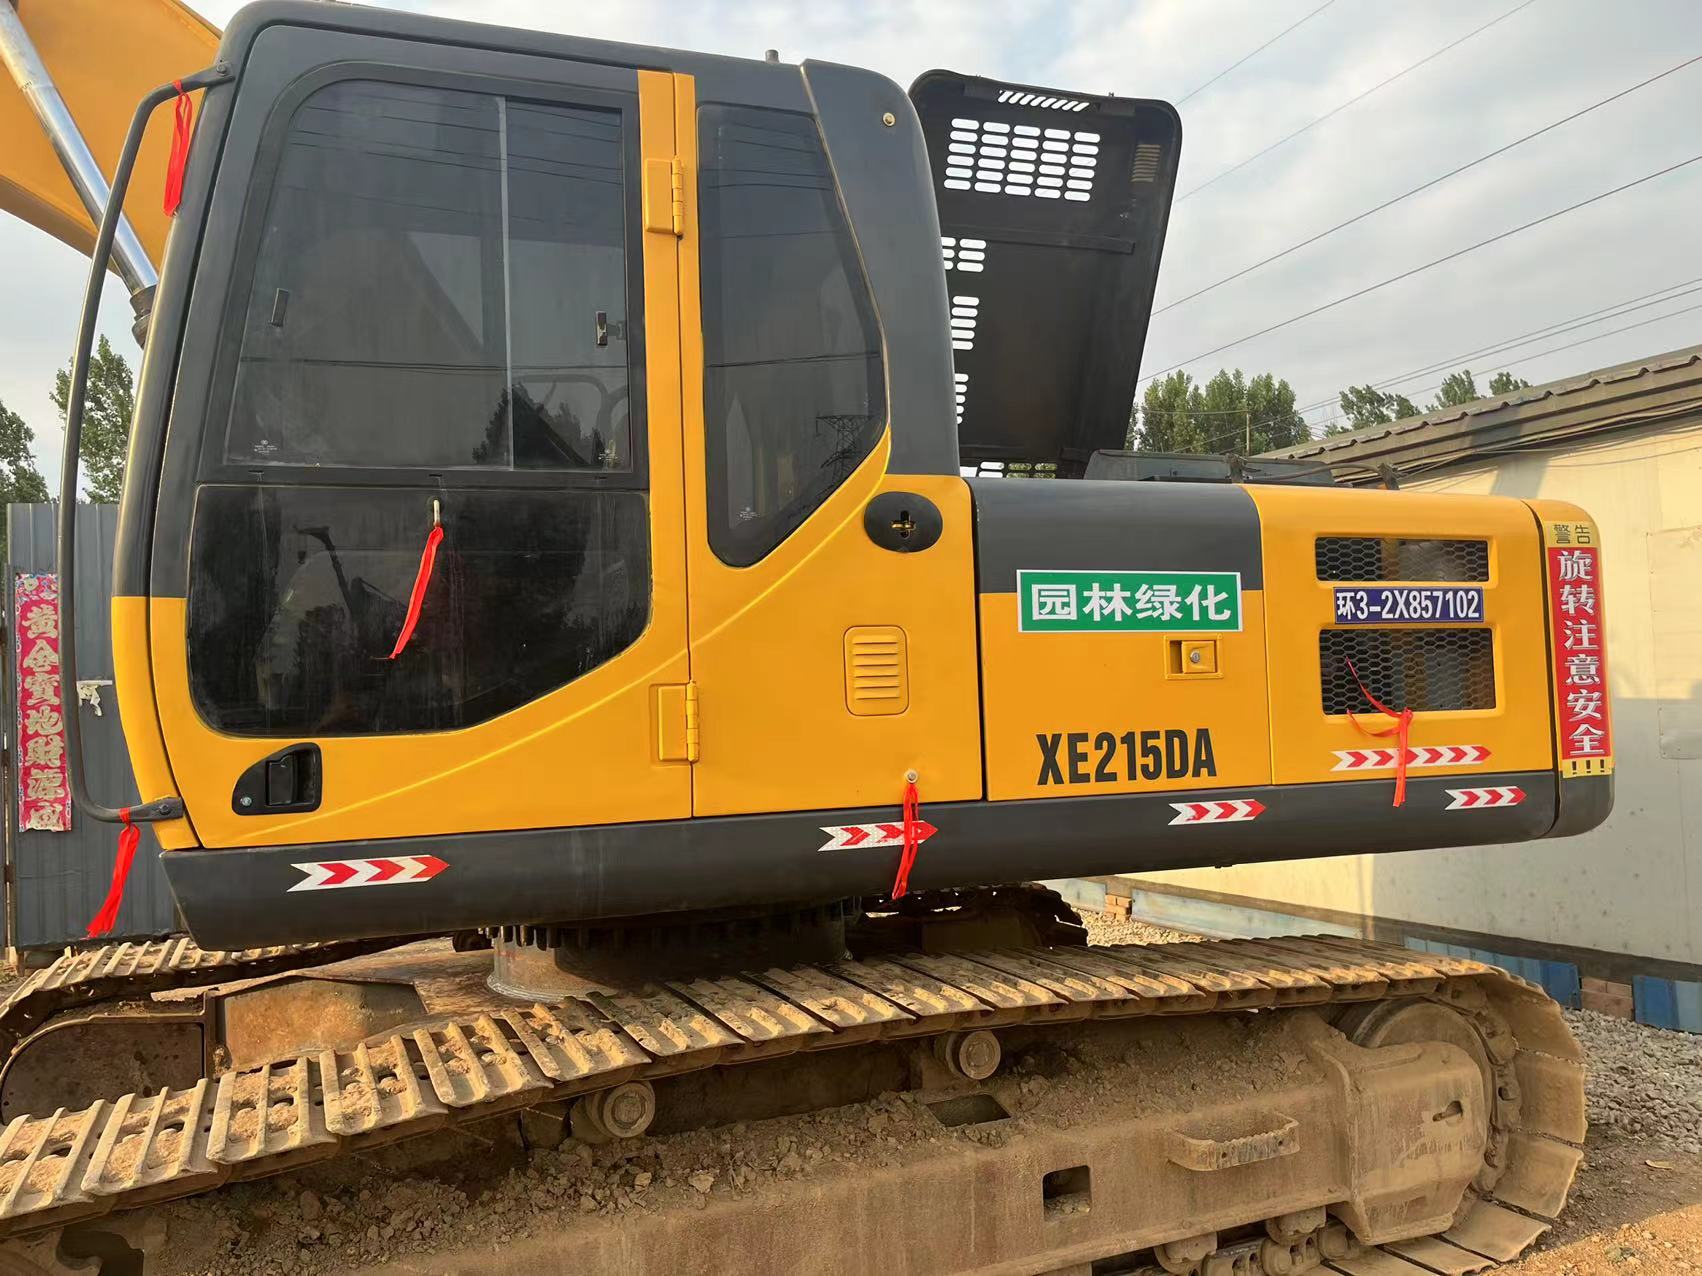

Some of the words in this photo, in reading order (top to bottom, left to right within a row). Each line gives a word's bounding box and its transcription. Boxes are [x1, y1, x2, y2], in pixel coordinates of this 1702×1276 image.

[1552, 524, 1591, 544] 警告
[1031, 583, 1231, 622] 园林绿化
[1336, 589, 1480, 620] 环3-2X857102
[1557, 550, 1604, 756] 旋转注意安全
[1036, 728, 1218, 786] XE215DA
